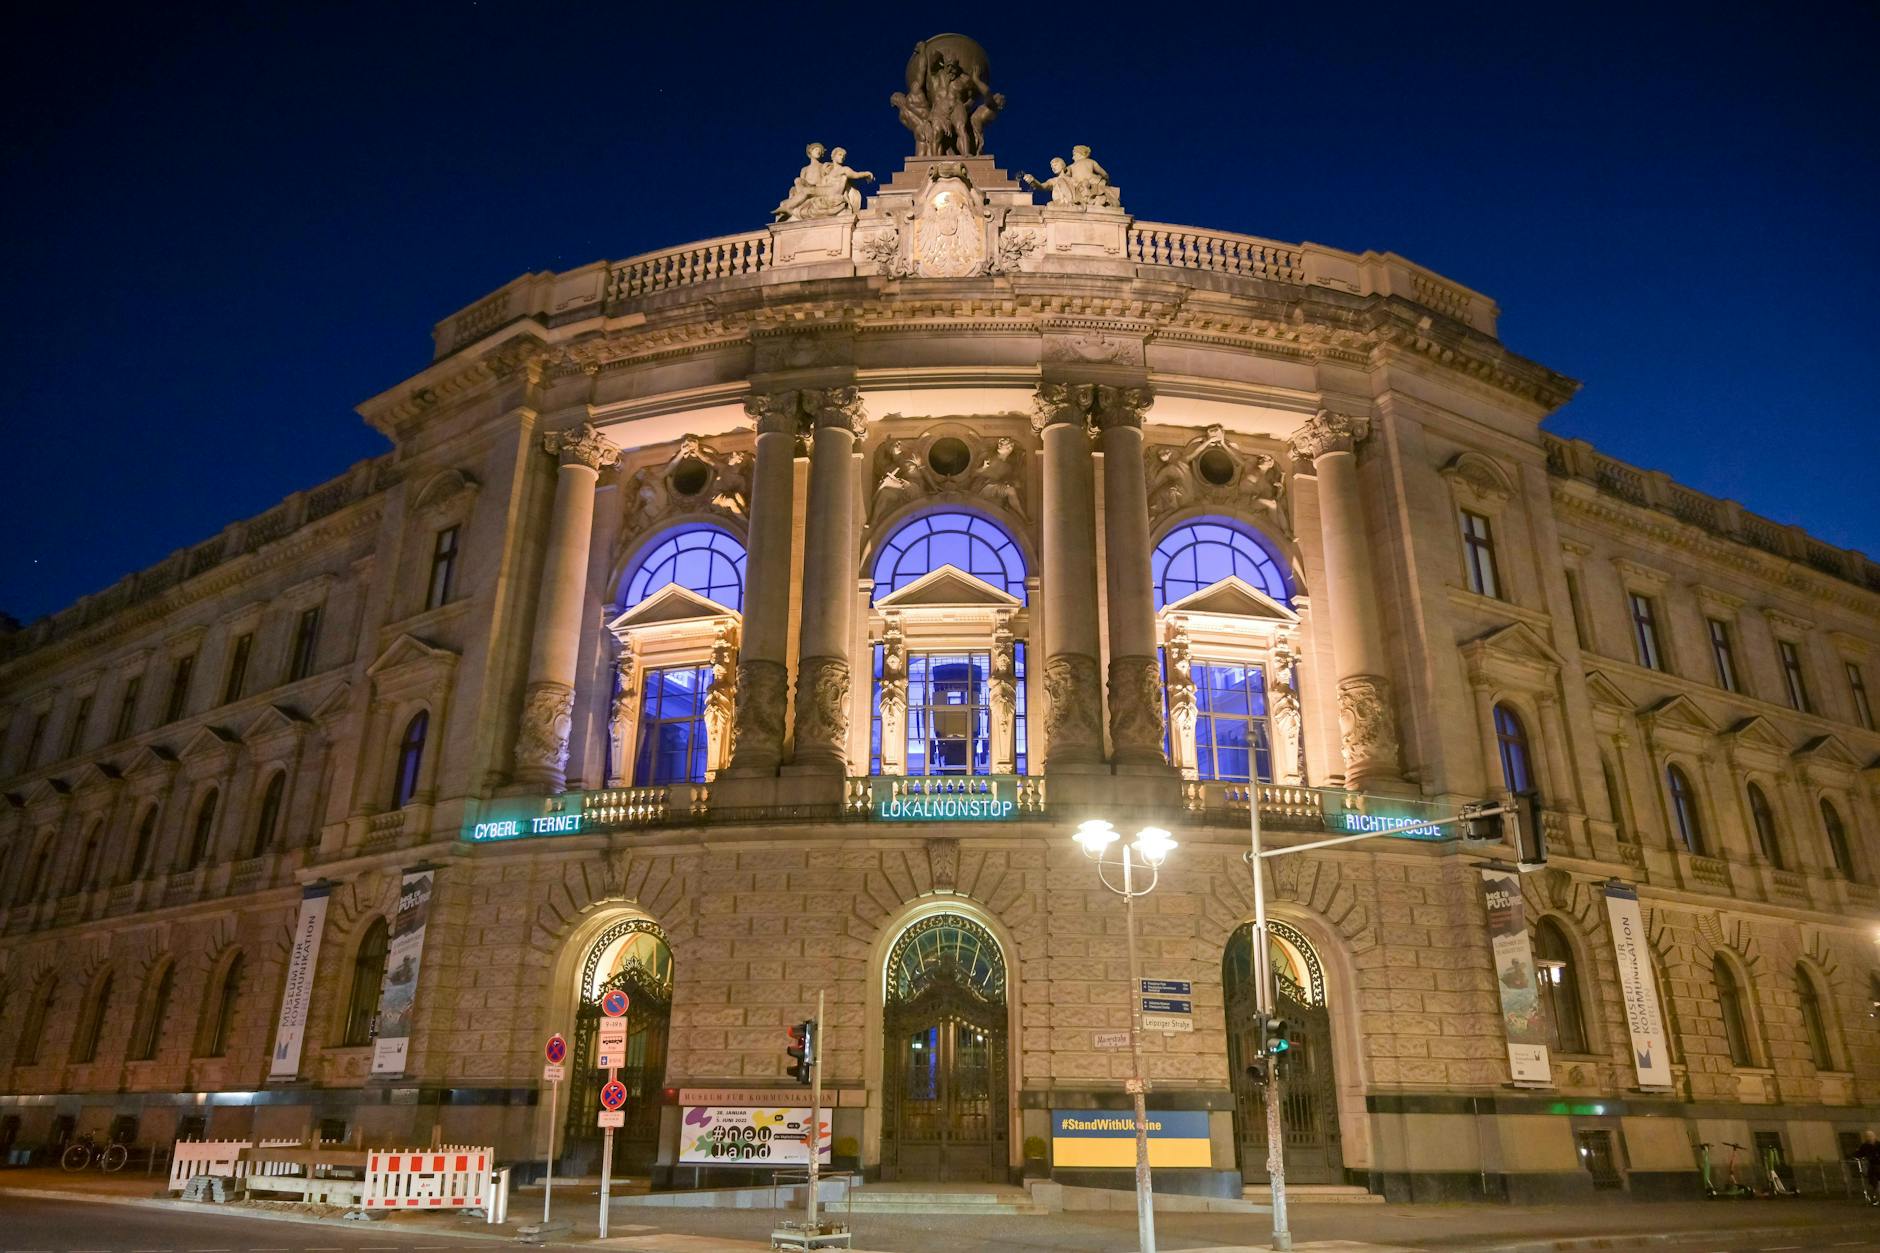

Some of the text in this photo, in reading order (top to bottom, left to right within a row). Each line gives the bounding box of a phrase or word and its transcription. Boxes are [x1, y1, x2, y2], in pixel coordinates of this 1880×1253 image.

[881, 800, 1012, 817] LOKALNONSTOP
[474, 814, 583, 839] CYBERL TERNET
[290, 915, 316, 1027] KOMMUNIKATION
[1621, 917, 1650, 1034] KOMMUNIKATION
[282, 969, 298, 1027] MUSEUM
[1624, 971, 1641, 1034] MUSEUM
[1146, 1018, 1190, 1030] Leipziger Straße
[685, 1093, 722, 1101] MUSEUM
[749, 1093, 832, 1102] KOMMUNIKATON
[1062, 1118, 1162, 1131] #StandWithUkine
[713, 1126, 770, 1142] #neu
[715, 1143, 769, 1159] land
